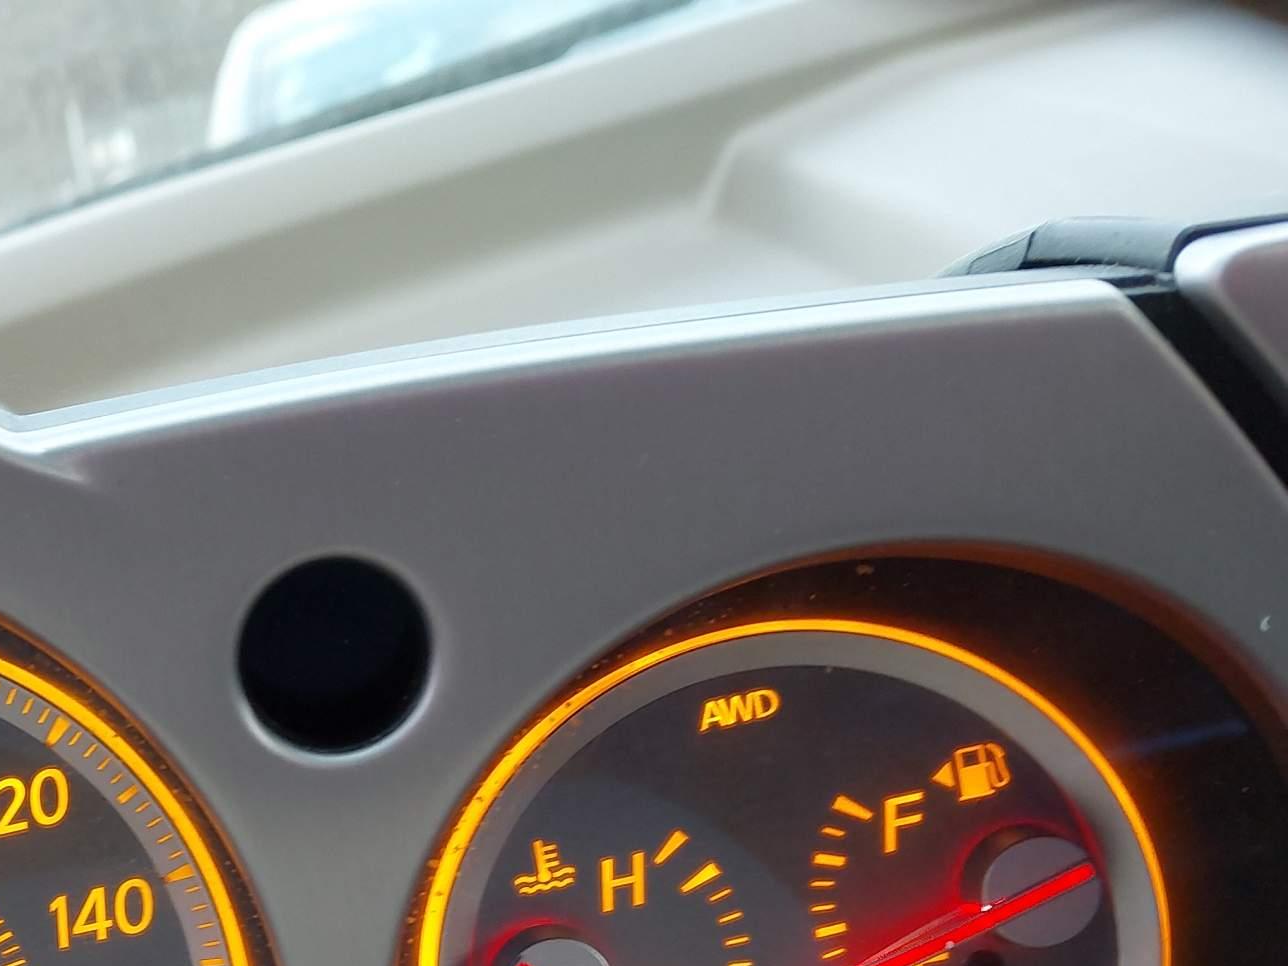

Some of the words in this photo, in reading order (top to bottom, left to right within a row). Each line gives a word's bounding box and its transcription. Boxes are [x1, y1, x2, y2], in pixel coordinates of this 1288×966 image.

[699, 688, 779, 732] AWD
[883, 791, 924, 853] F
[601, 851, 646, 912] H
[48, 877, 155, 950] 140
